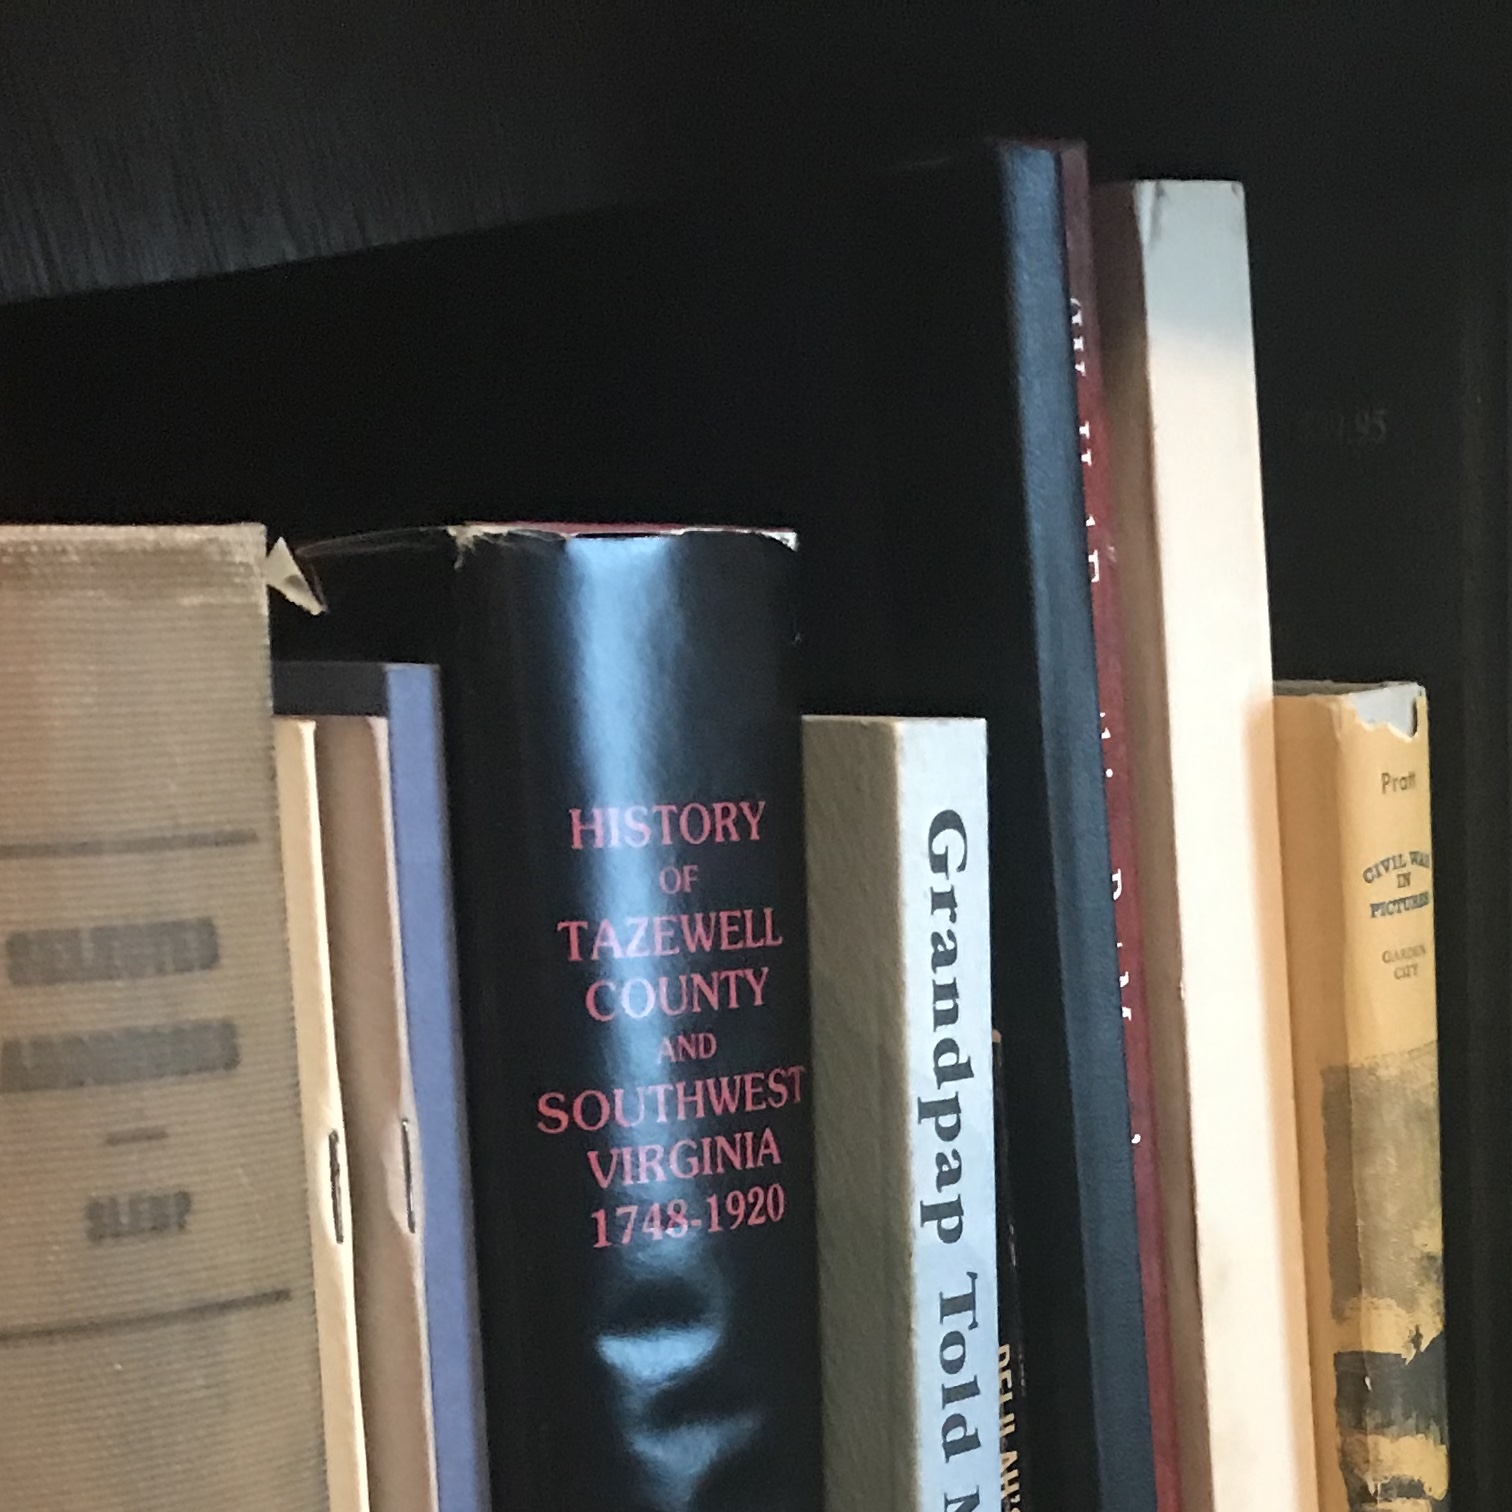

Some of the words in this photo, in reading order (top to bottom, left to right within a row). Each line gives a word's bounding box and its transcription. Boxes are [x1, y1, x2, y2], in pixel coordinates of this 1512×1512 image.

[1381, 771, 1417, 794] Pratt
[568, 801, 767, 850] HISTORY
[658, 864, 699, 895] OF
[1362, 853, 1407, 884] CIVIL
[1409, 851, 1431, 869] WAR
[1396, 872, 1411, 888] IN
[1370, 891, 1429, 918] PICTURES
[557, 907, 783, 962] TAZEWELL
[1382, 944, 1427, 964] GARDEN
[1393, 963, 1419, 980] CITY
[585, 967, 770, 1023] COUNTY
[917, 808, 976, 1245] Grandpap
[657, 1033, 717, 1064] AND
[537, 1065, 807, 1135] SOUTHWEST
[587, 1127, 782, 1190] VIRGINIA
[592, 1183, 786, 1249] 1748-1920
[938, 1270, 983, 1464] Told
